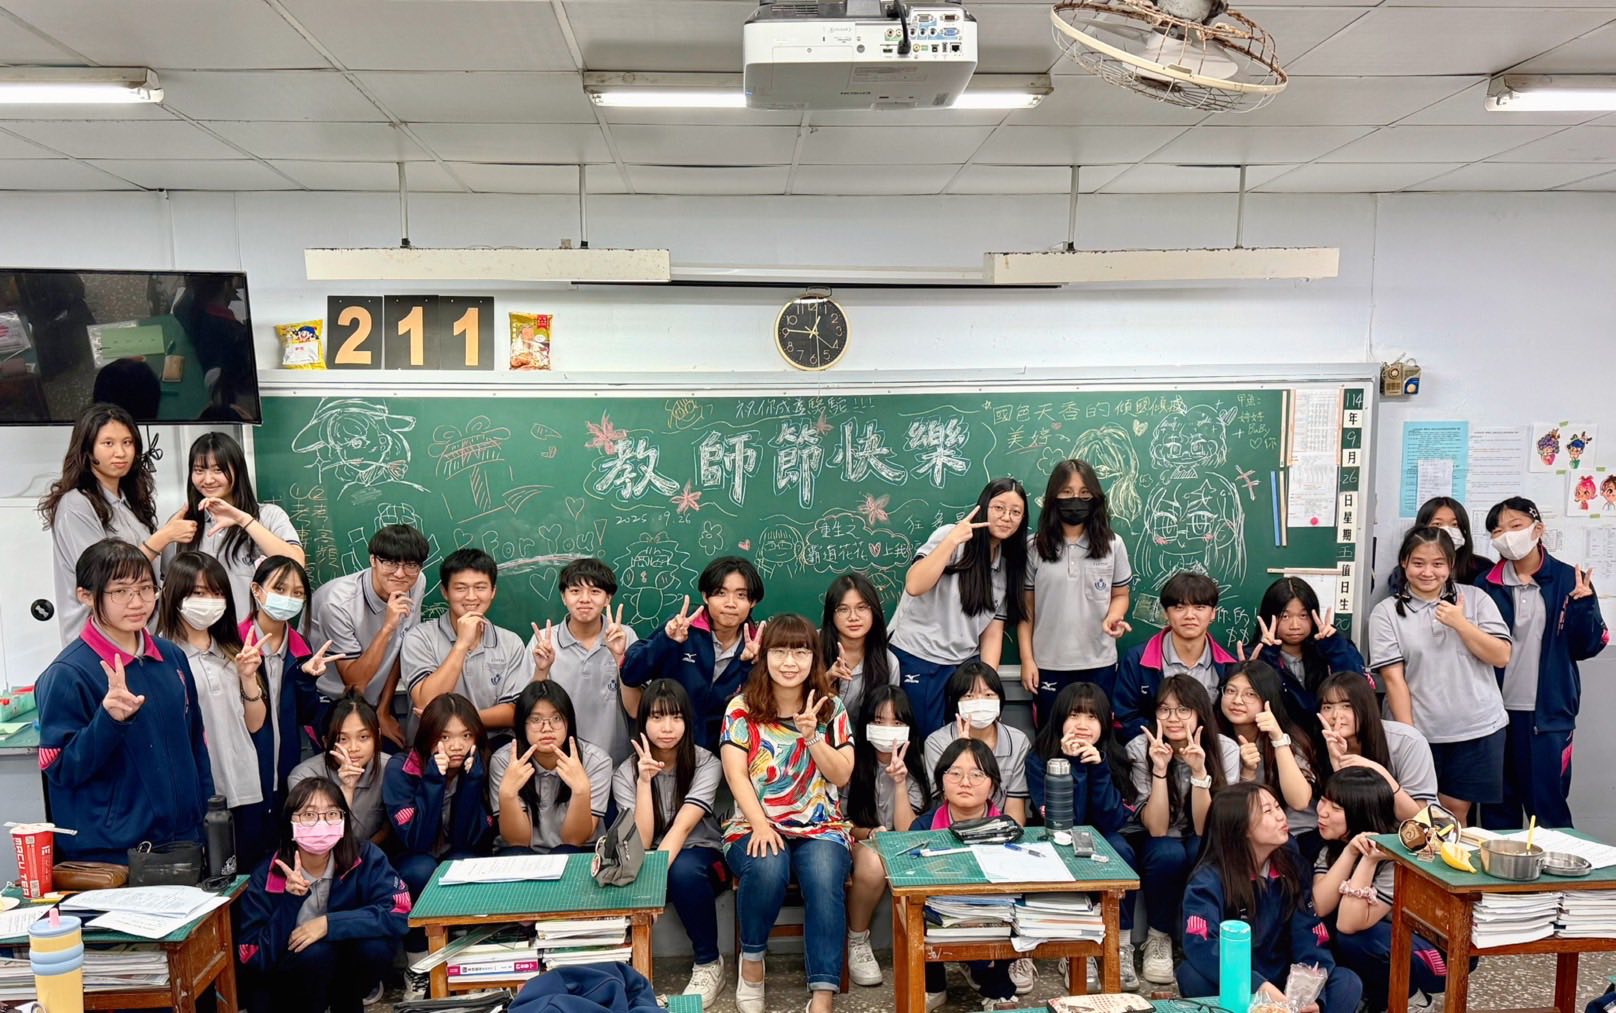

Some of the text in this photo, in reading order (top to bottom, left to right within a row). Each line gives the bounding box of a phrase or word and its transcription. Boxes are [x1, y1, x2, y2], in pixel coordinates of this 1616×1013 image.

[785, 315, 798, 325] 10
[830, 313, 839, 324] 2
[782, 327, 790, 338] 9
[835, 326, 843, 337] 3
[786, 341, 794, 352] 8
[832, 339, 839, 349] 4
[797, 350, 805, 360] 7
[809, 354, 818, 365] 6
[823, 350, 831, 361] 5
[594, 416, 970, 506] 教師節快樂
[820, 520, 861, 539] 重生之
